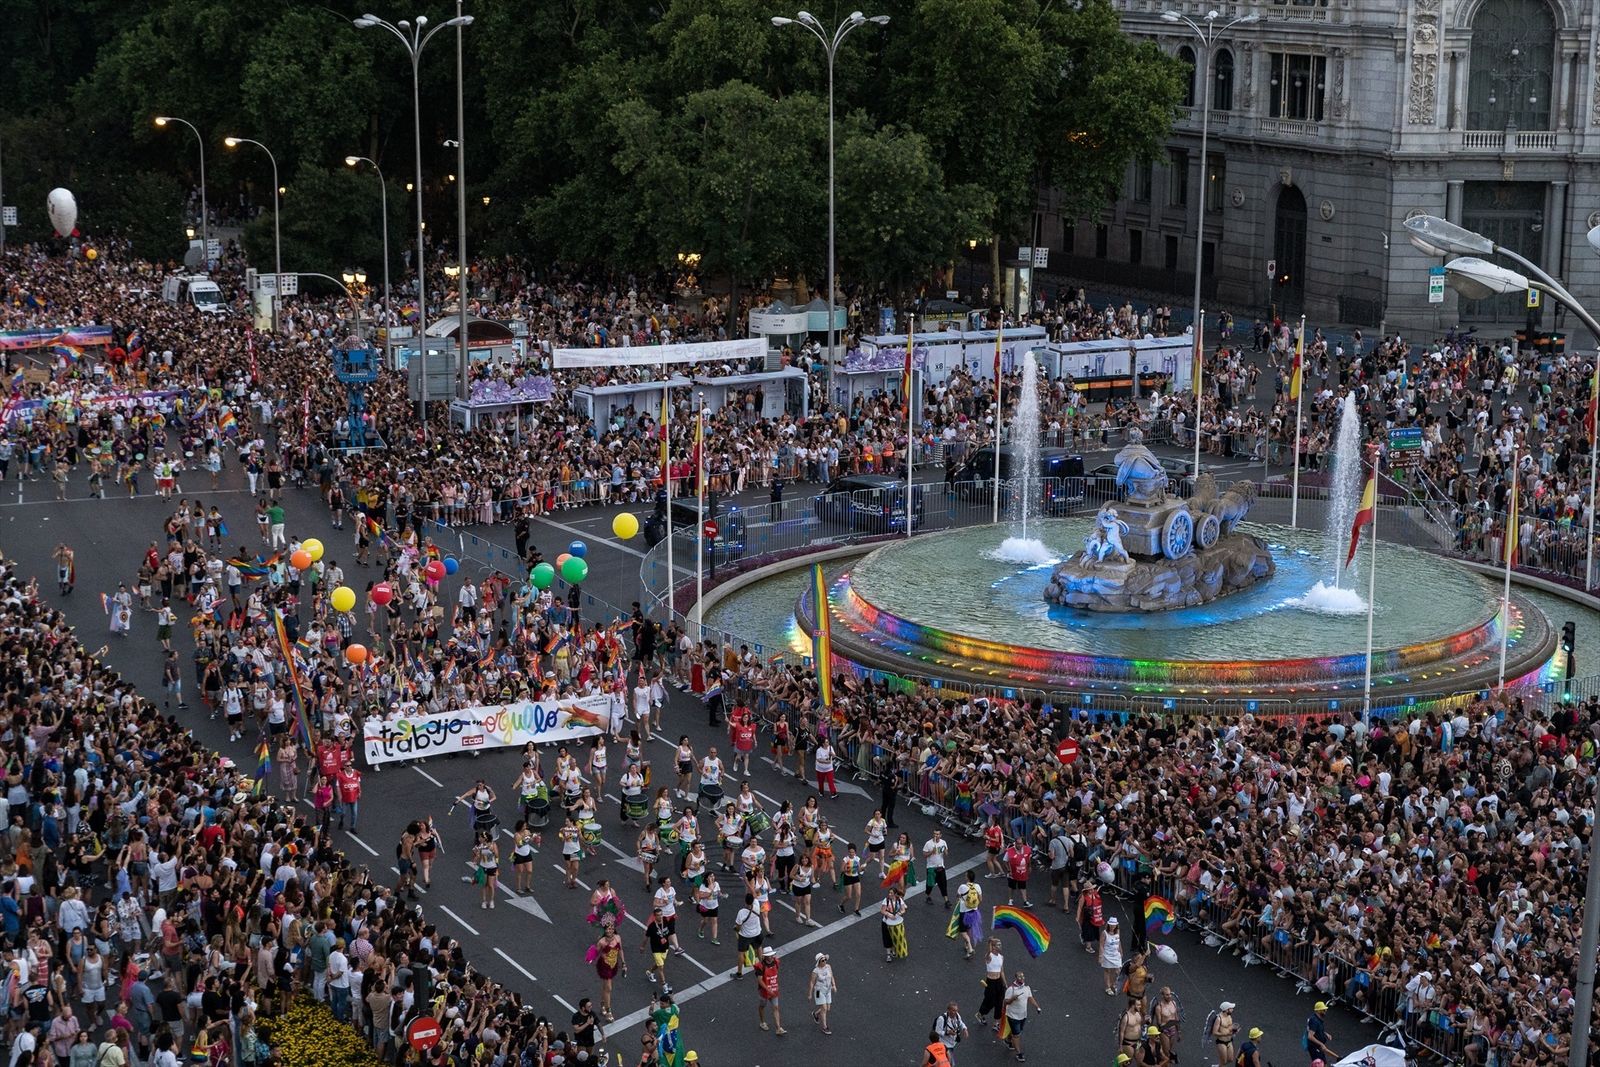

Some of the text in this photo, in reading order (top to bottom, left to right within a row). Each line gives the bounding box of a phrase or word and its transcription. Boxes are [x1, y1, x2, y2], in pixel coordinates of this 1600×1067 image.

[371, 742, 380, 757] al
[379, 718, 463, 757] trabajo
[485, 704, 558, 744] orgullo
[462, 736, 483, 746] CCOO
